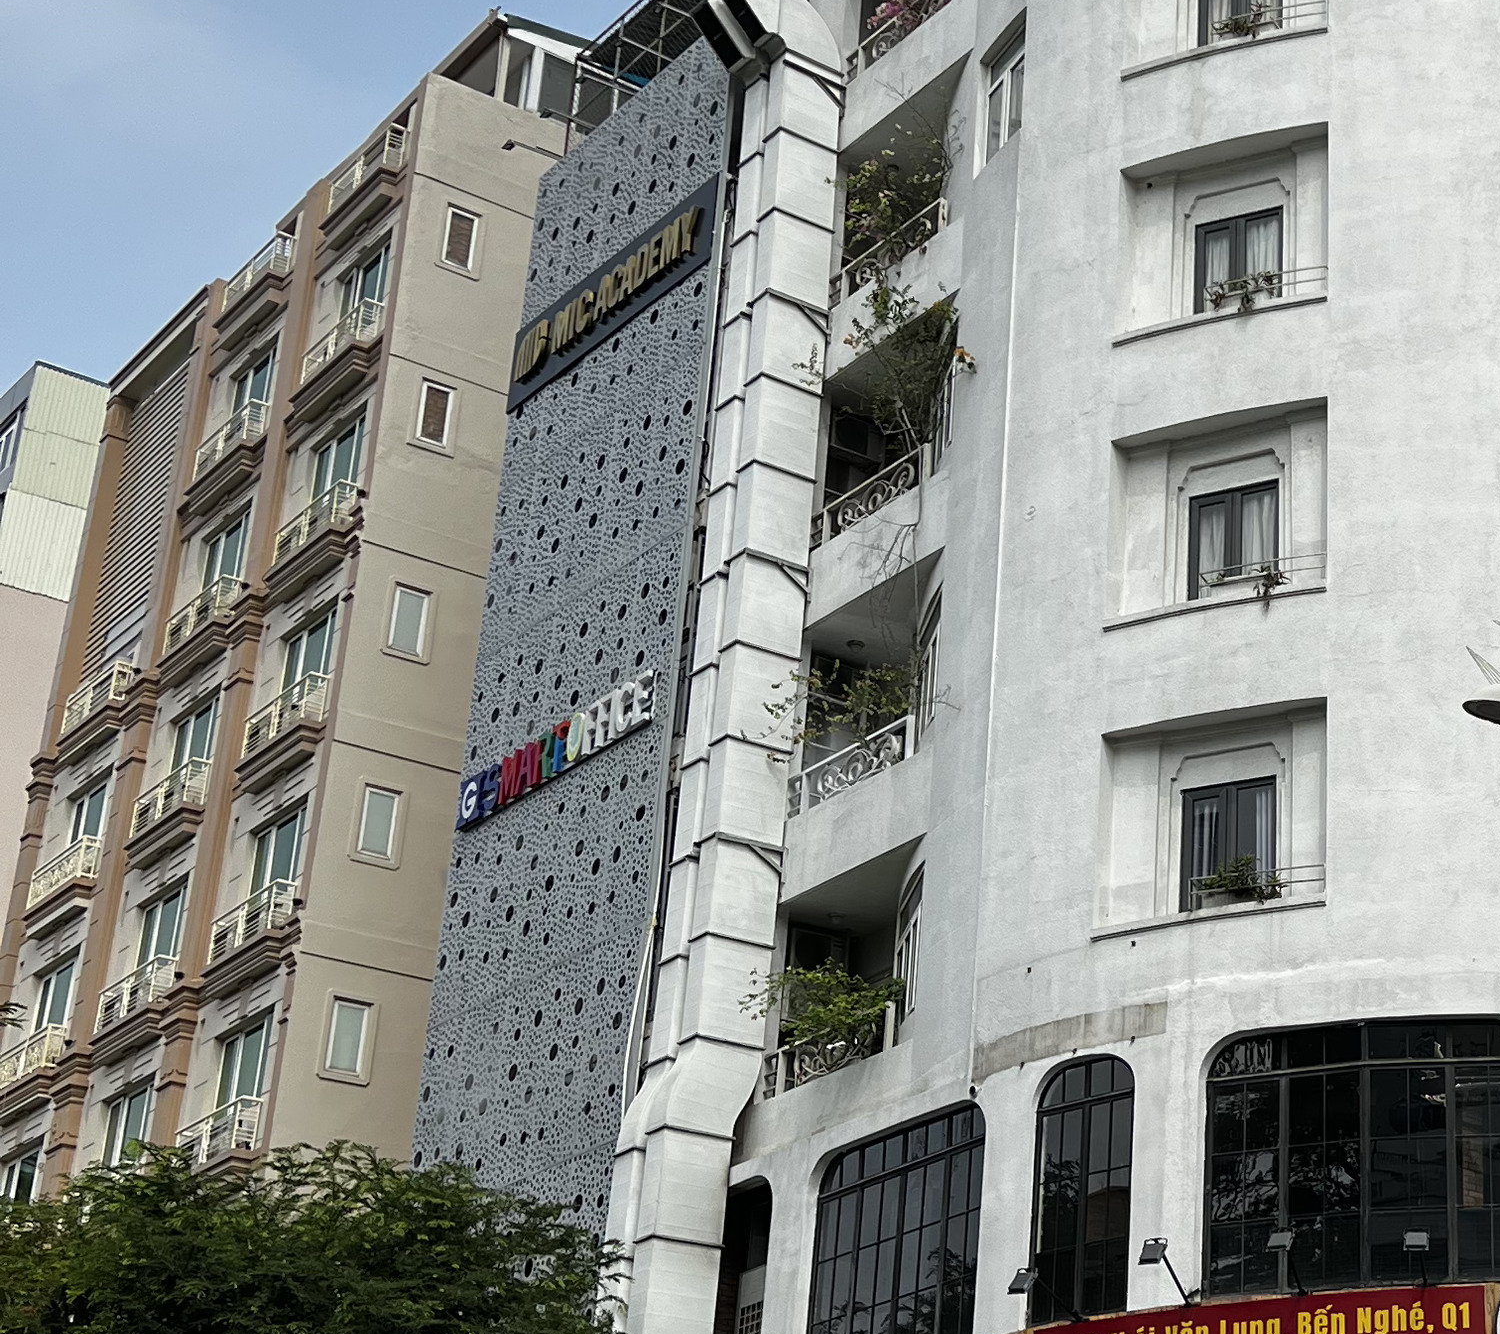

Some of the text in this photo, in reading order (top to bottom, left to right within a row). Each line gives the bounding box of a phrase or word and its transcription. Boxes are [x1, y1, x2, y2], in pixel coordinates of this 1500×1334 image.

[551, 205, 704, 355] MIC ACADEMY
[1357, 1300, 1434, 1334] Nghé,
[1442, 1302, 1471, 1331] Q1
